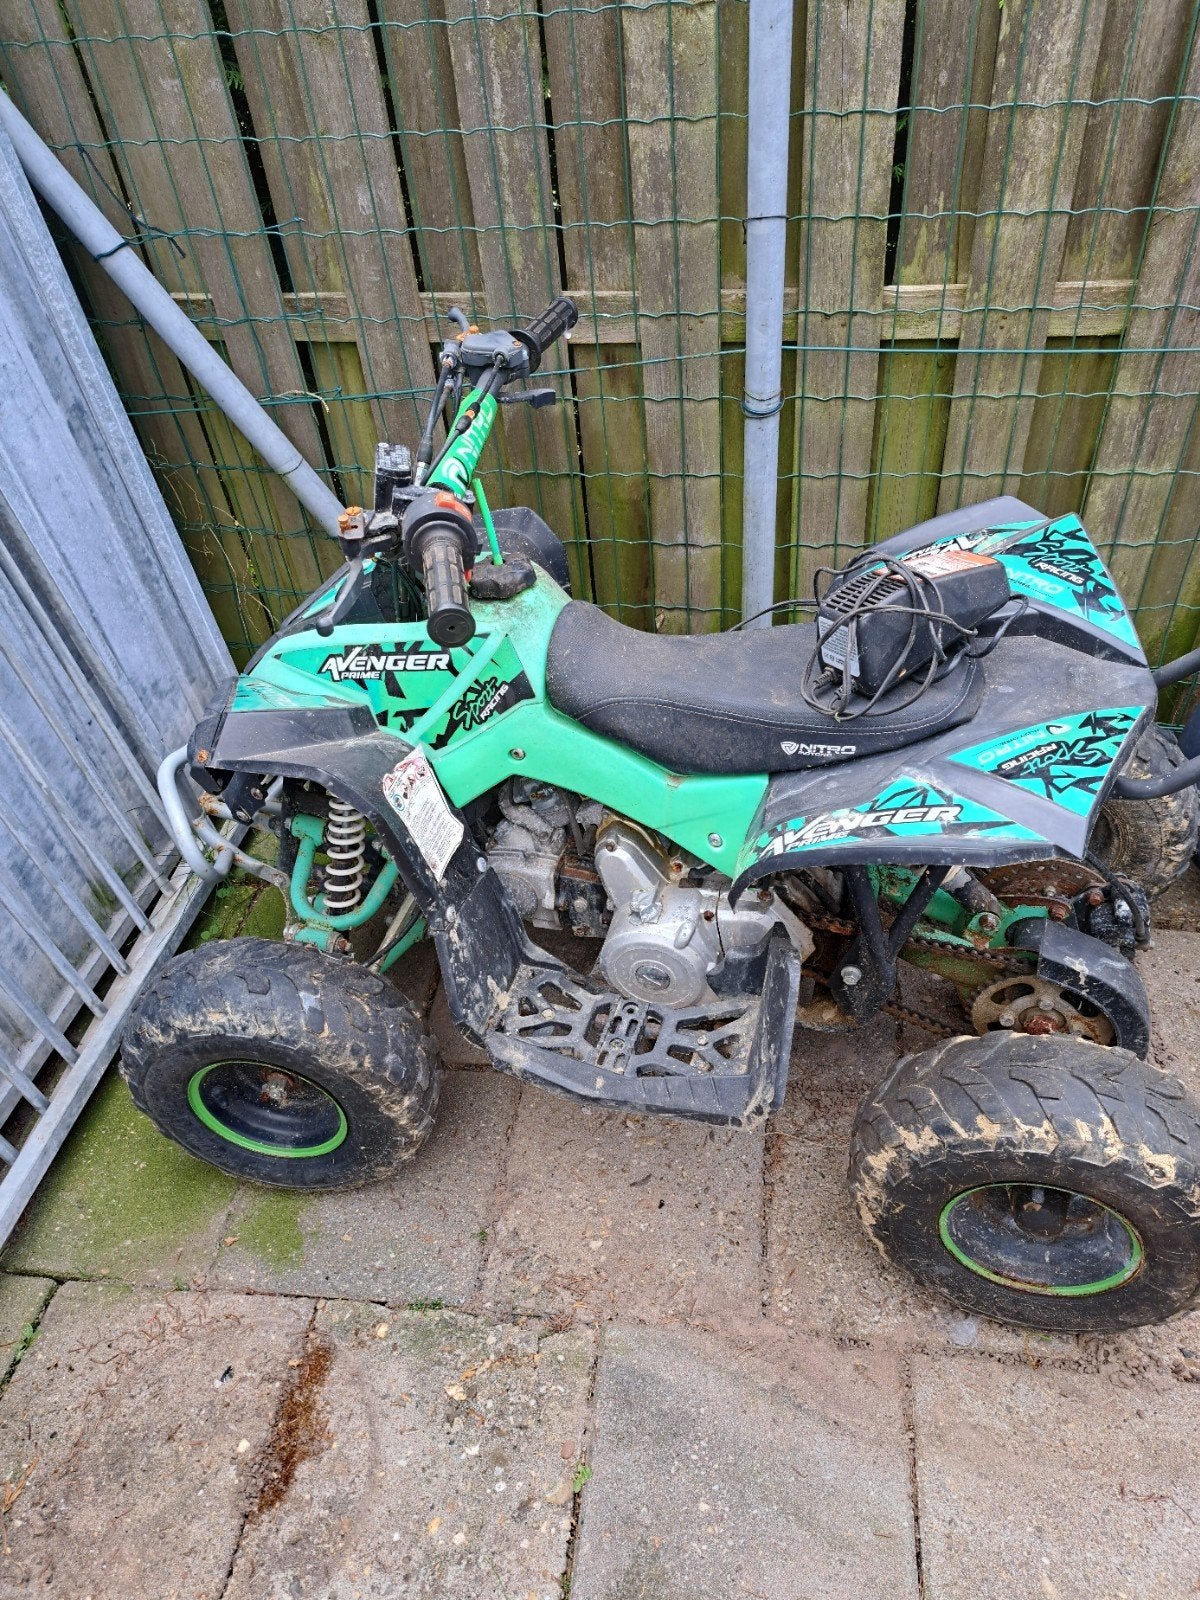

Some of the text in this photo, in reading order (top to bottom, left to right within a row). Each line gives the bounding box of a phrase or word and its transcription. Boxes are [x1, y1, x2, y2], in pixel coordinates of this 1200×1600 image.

[1034, 561, 1086, 585] RACING
[321, 646, 451, 682] AVENGER
[341, 670, 381, 680] PRIME
[453, 678, 498, 729] Sport
[480, 683, 510, 721] RACING
[798, 743, 857, 755] NITRO
[977, 730, 1048, 766] NITRO
[1001, 742, 1058, 771] RACING
[1020, 740, 1102, 776] Sport
[759, 806, 963, 858] AVENGER
[783, 829, 850, 851] PRIME
